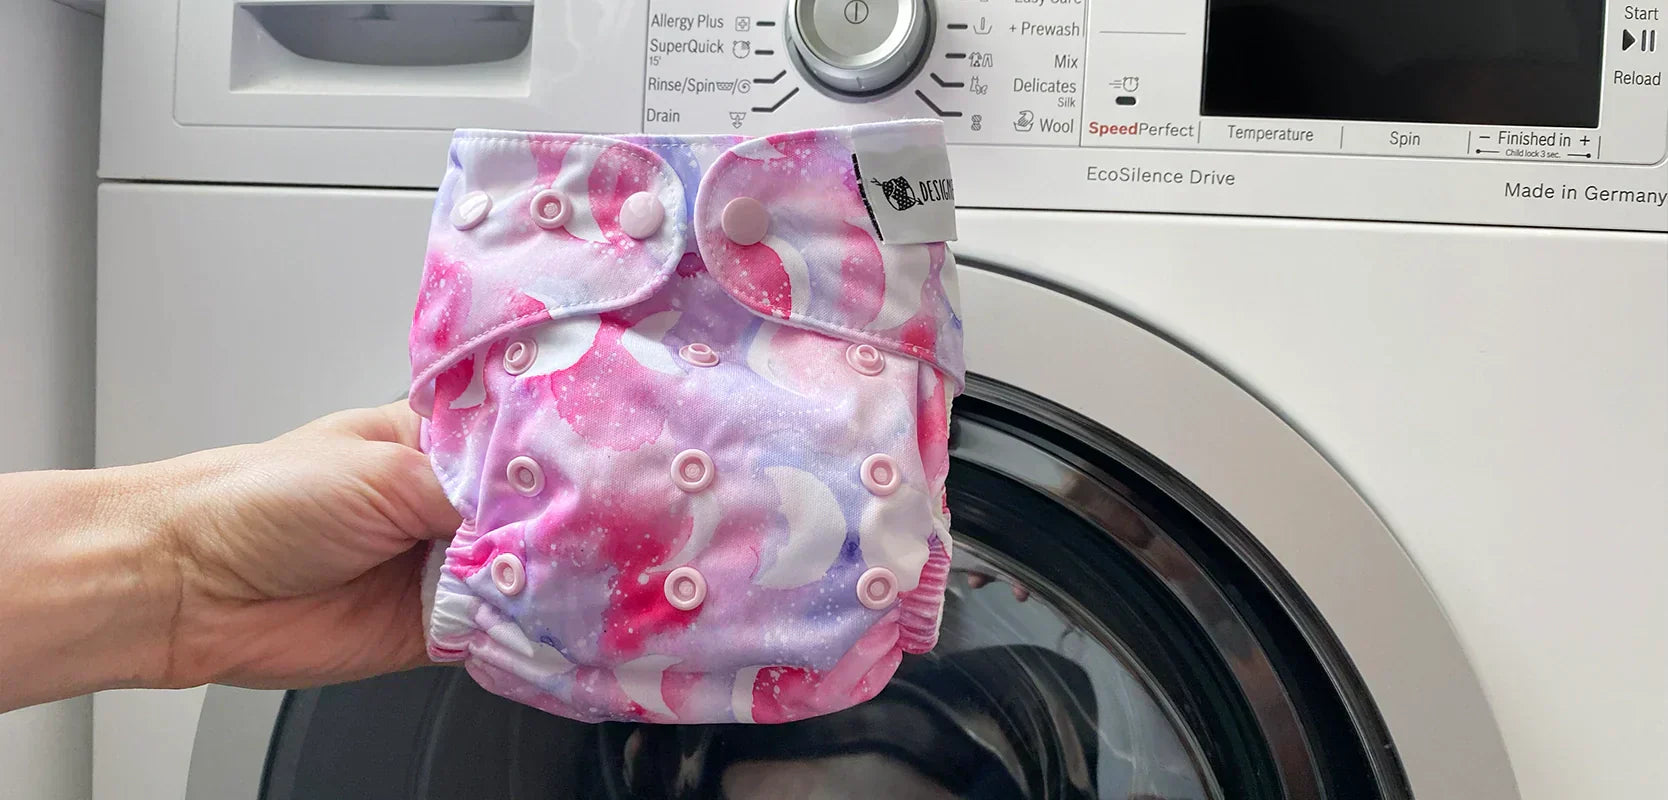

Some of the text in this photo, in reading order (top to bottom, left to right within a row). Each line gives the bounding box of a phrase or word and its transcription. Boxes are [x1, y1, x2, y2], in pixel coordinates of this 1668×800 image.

[1624, 5, 1660, 21] Start
[651, 13, 725, 32] Allergy Plus
[1021, 21, 1080, 37] Prewash
[649, 38, 724, 55] SuperQuick
[1054, 54, 1079, 69] Mix
[647, 76, 716, 95] Rinse/Spin
[1013, 77, 1077, 94] Delicates
[1613, 70, 1662, 86] Reload
[1057, 97, 1076, 108] Silk
[646, 107, 681, 123] Drain
[1039, 118, 1074, 134] Wool
[1088, 121, 1194, 138] SpeedPerfect
[1227, 124, 1314, 143] Temperature
[1389, 130, 1421, 148] Spin
[1498, 130, 1555, 147] Finished
[1559, 132, 1571, 147] in
[1505, 149, 1524, 158] Child
[1525, 150, 1540, 158] lock
[1540, 150, 1546, 159] 3
[1086, 166, 1236, 186] EcoSilence Drive
[1504, 182, 1668, 207] Made in Germany
